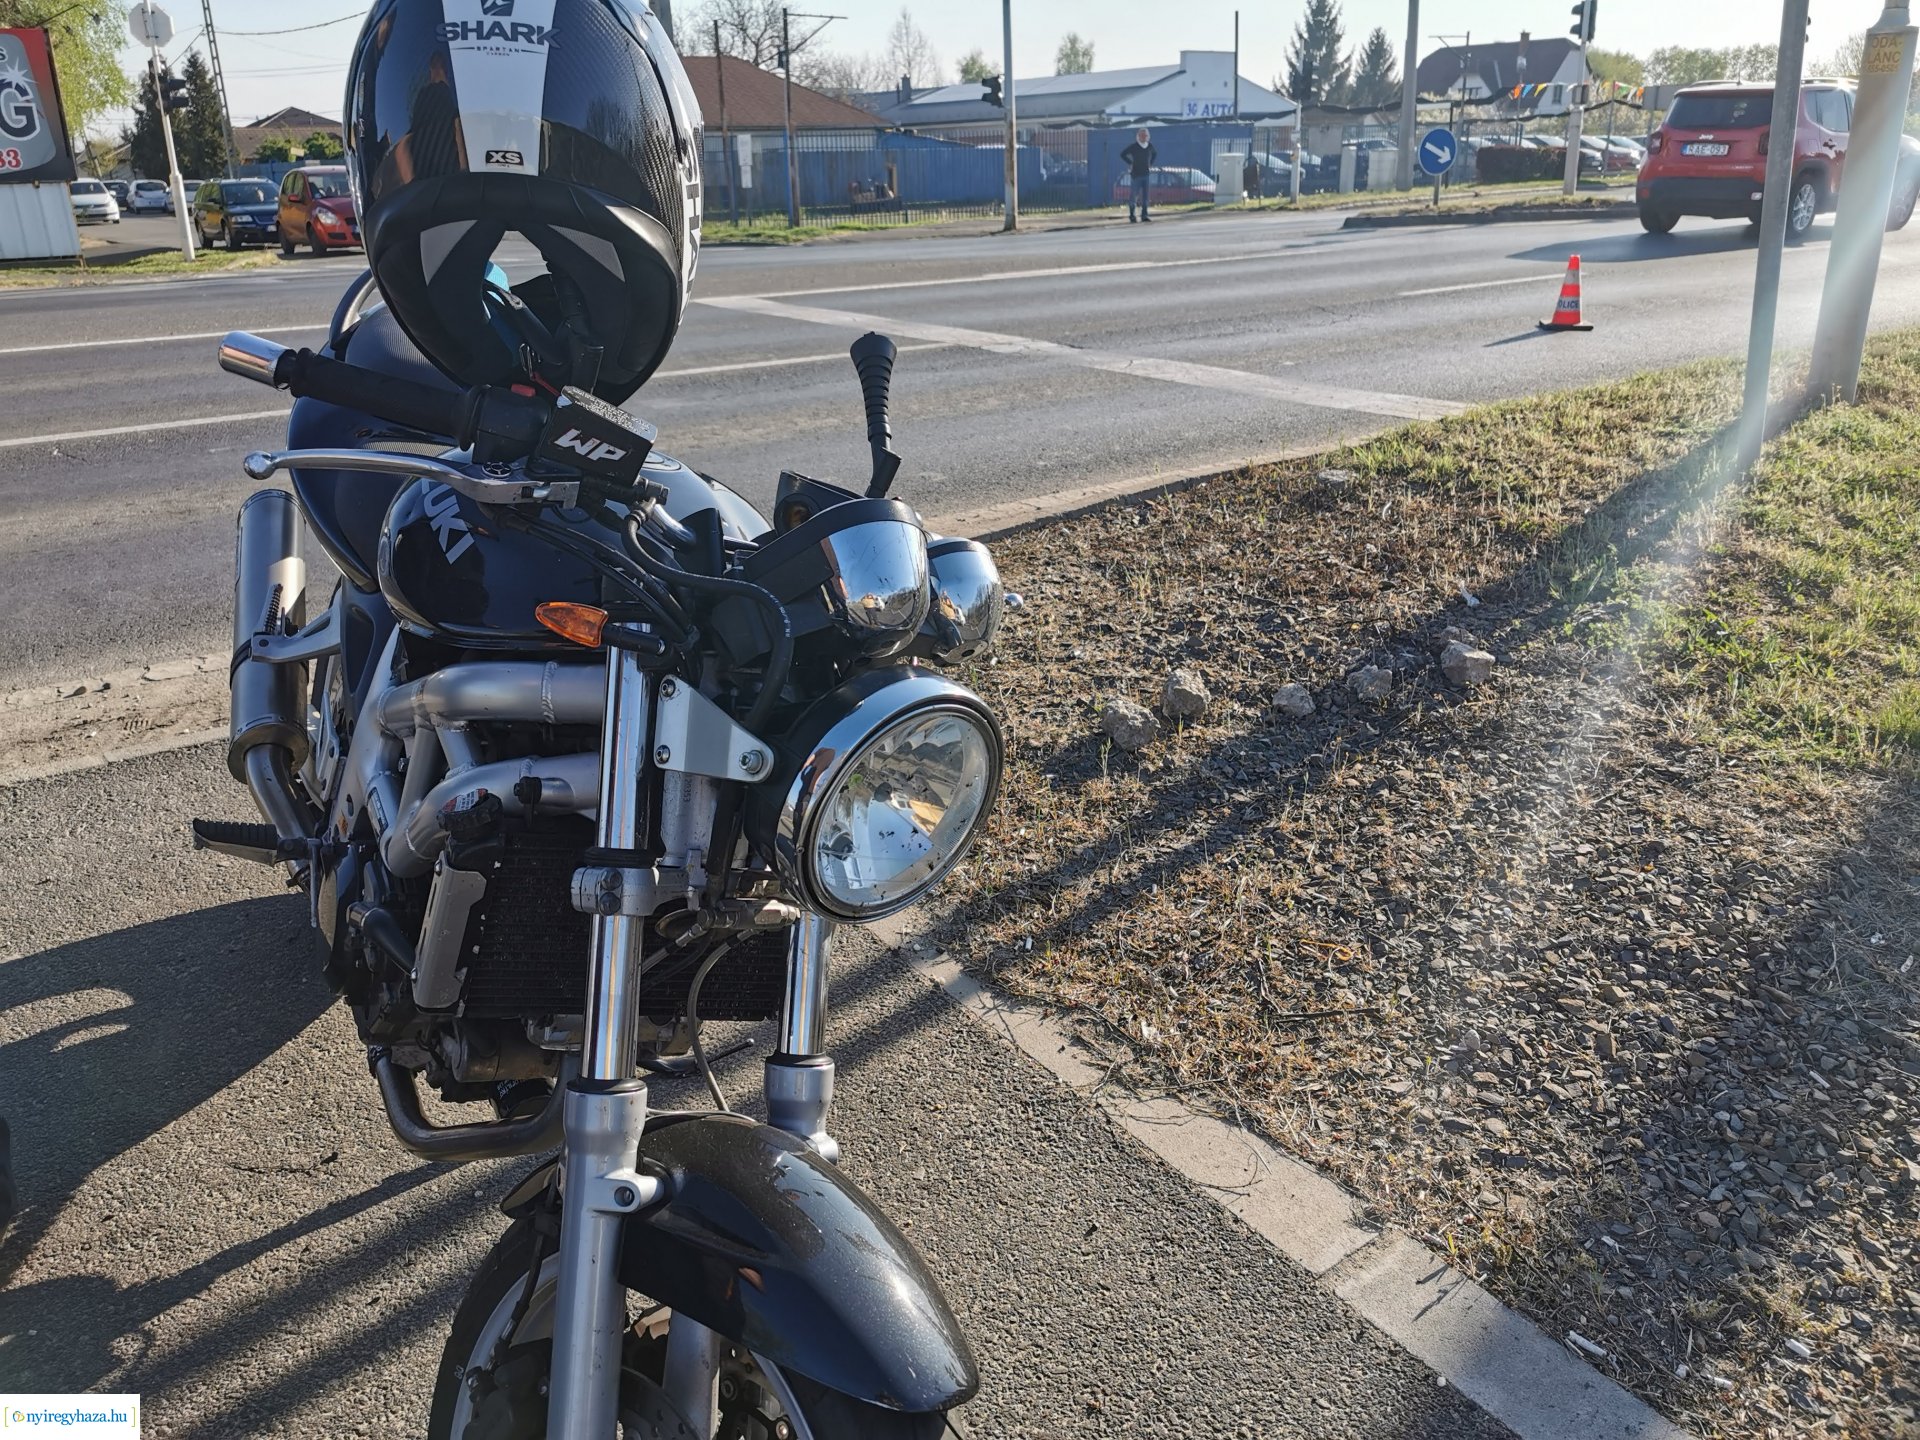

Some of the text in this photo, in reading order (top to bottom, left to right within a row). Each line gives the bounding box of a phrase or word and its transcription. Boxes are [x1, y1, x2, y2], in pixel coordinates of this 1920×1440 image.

[434, 20, 562, 49] SHARK
[476, 45, 520, 53] SPARTAN
[488, 151, 521, 164] XS
[554, 428, 628, 461] WP
